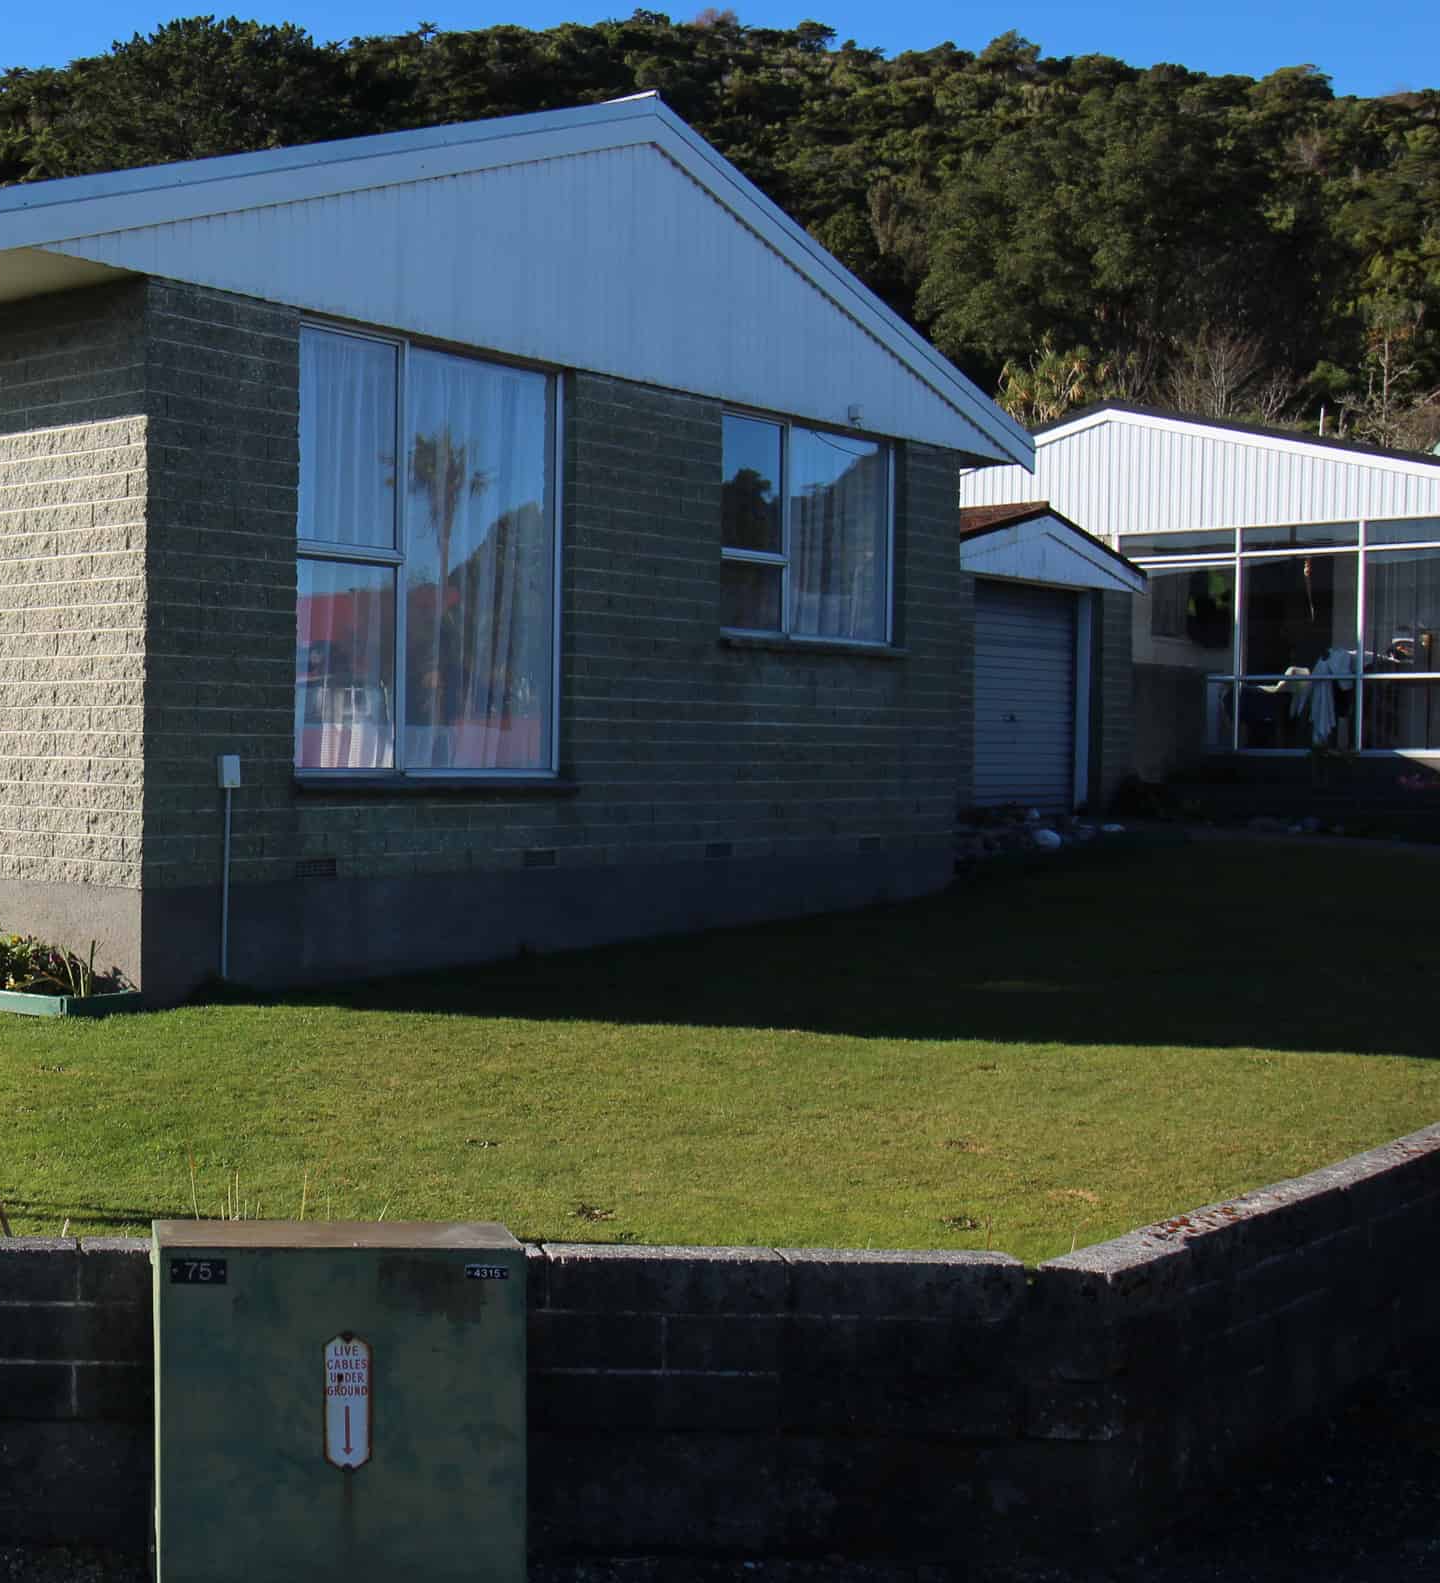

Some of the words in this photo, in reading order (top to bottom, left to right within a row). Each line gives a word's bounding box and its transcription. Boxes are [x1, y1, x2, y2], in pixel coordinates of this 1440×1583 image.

[183, 1262, 212, 1281] 75
[334, 1345, 359, 1356] LIVE
[327, 1359, 368, 1370] CABLES
[330, 1372, 365, 1383] UDER
[327, 1385, 368, 1396] GROUND
